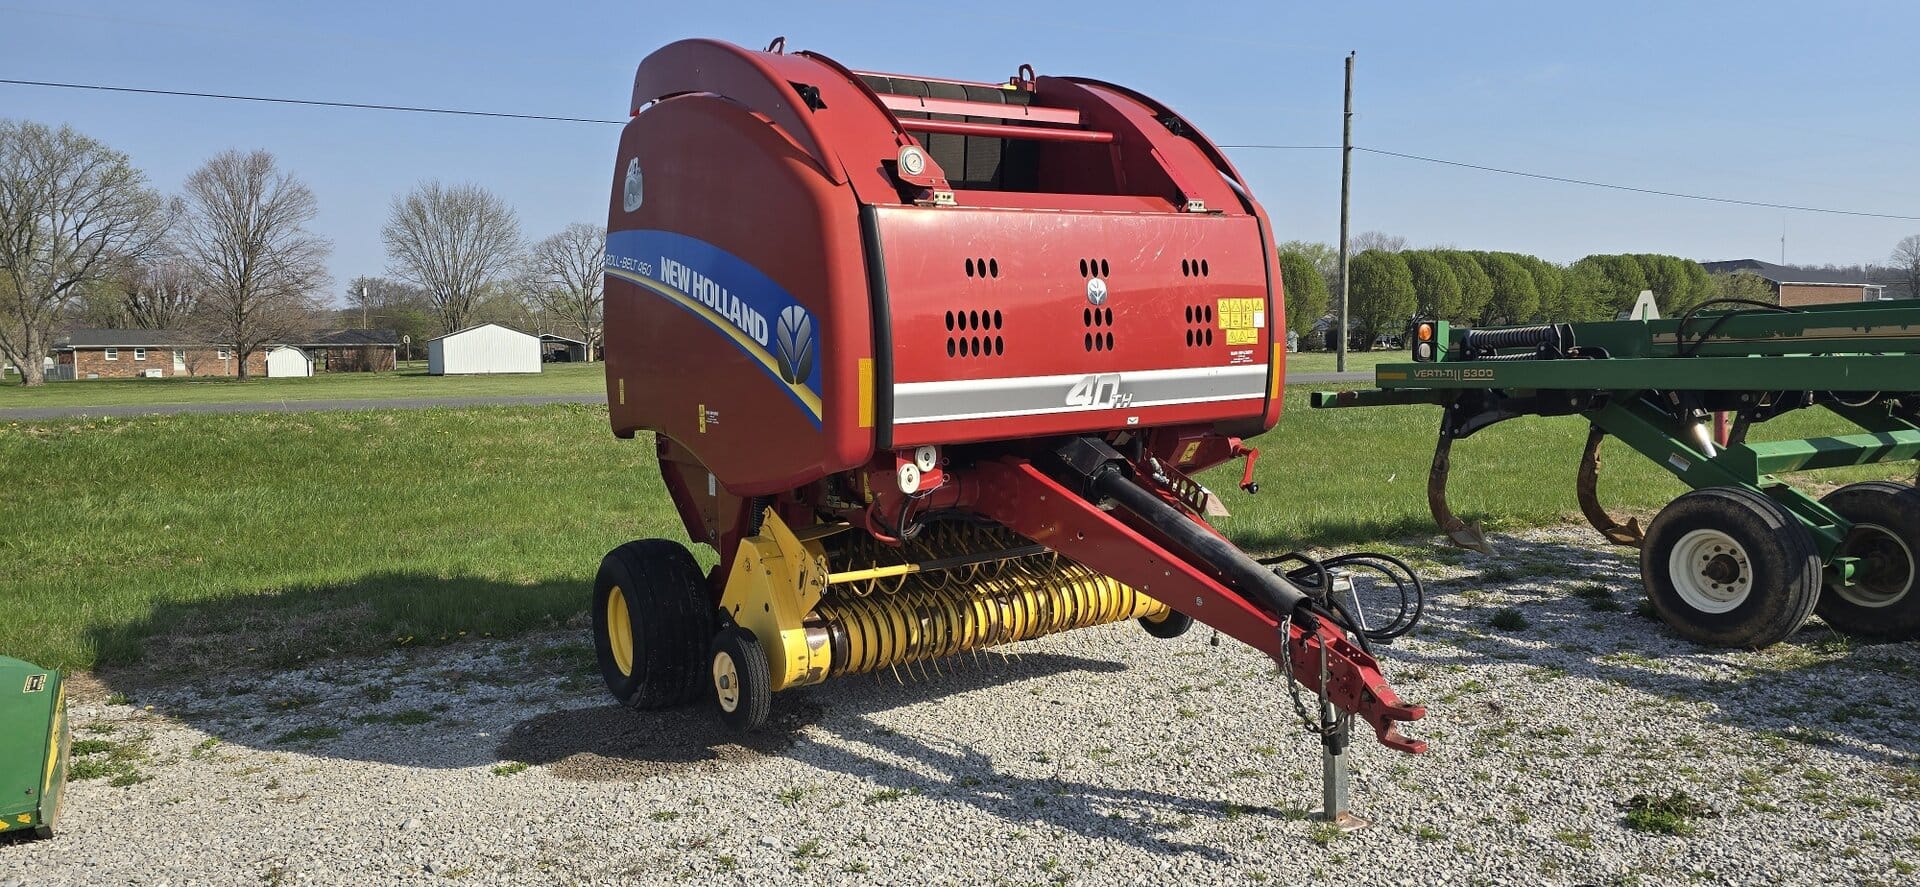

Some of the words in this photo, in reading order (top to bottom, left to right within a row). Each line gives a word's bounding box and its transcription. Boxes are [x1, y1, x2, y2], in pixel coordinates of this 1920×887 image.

[638, 261, 652, 276] 460
[661, 256, 690, 293] NEW
[692, 270, 768, 347] HOLLAND
[1463, 369, 1494, 378] 5300
